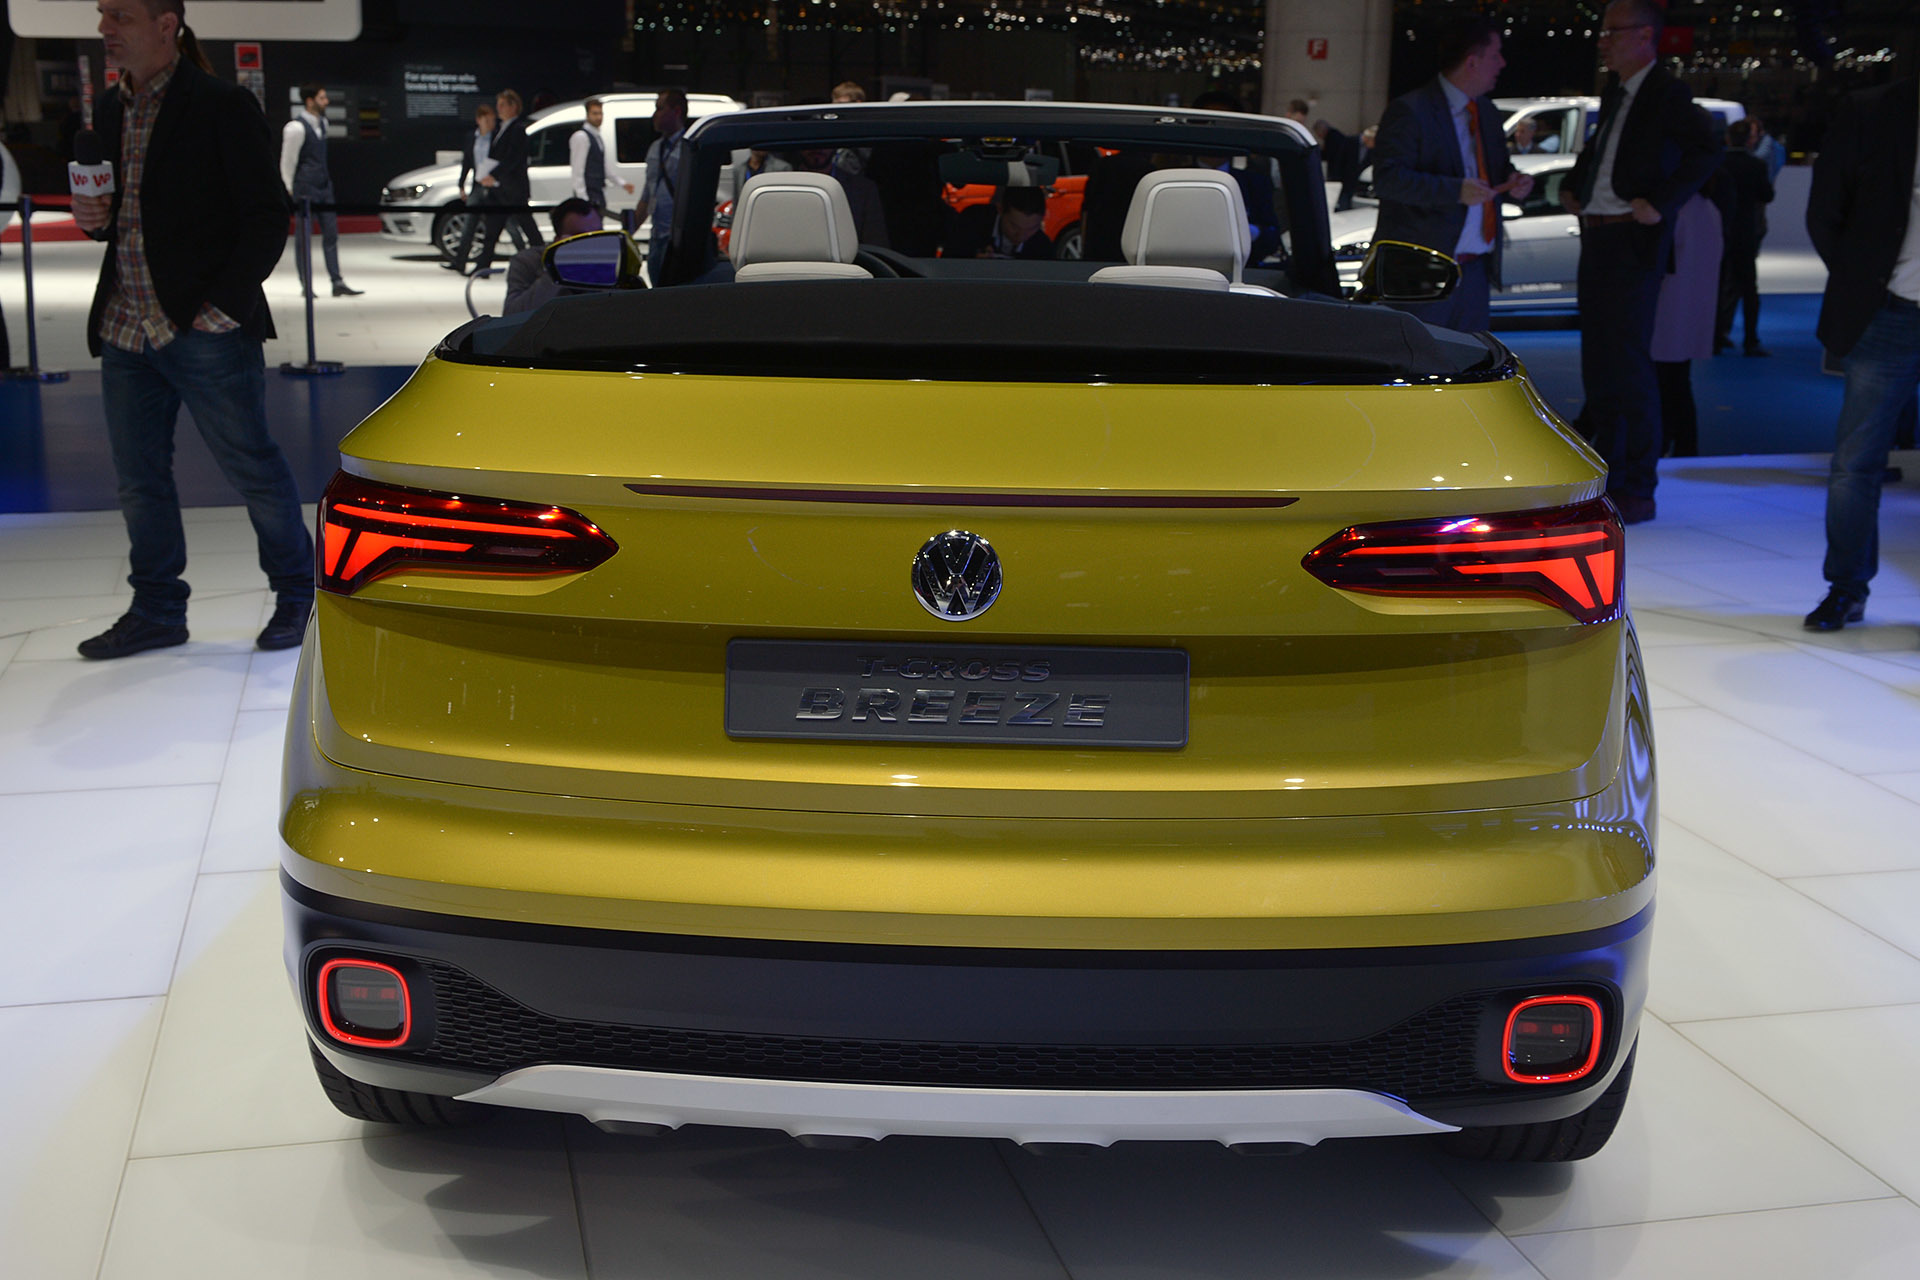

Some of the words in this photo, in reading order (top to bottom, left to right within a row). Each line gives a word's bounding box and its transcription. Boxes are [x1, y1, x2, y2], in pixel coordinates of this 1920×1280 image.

[405, 72, 419, 81] For
[420, 73, 457, 84] everyone
[857, 656, 1050, 682] T-CROSS
[796, 687, 1112, 727] BREEZE
